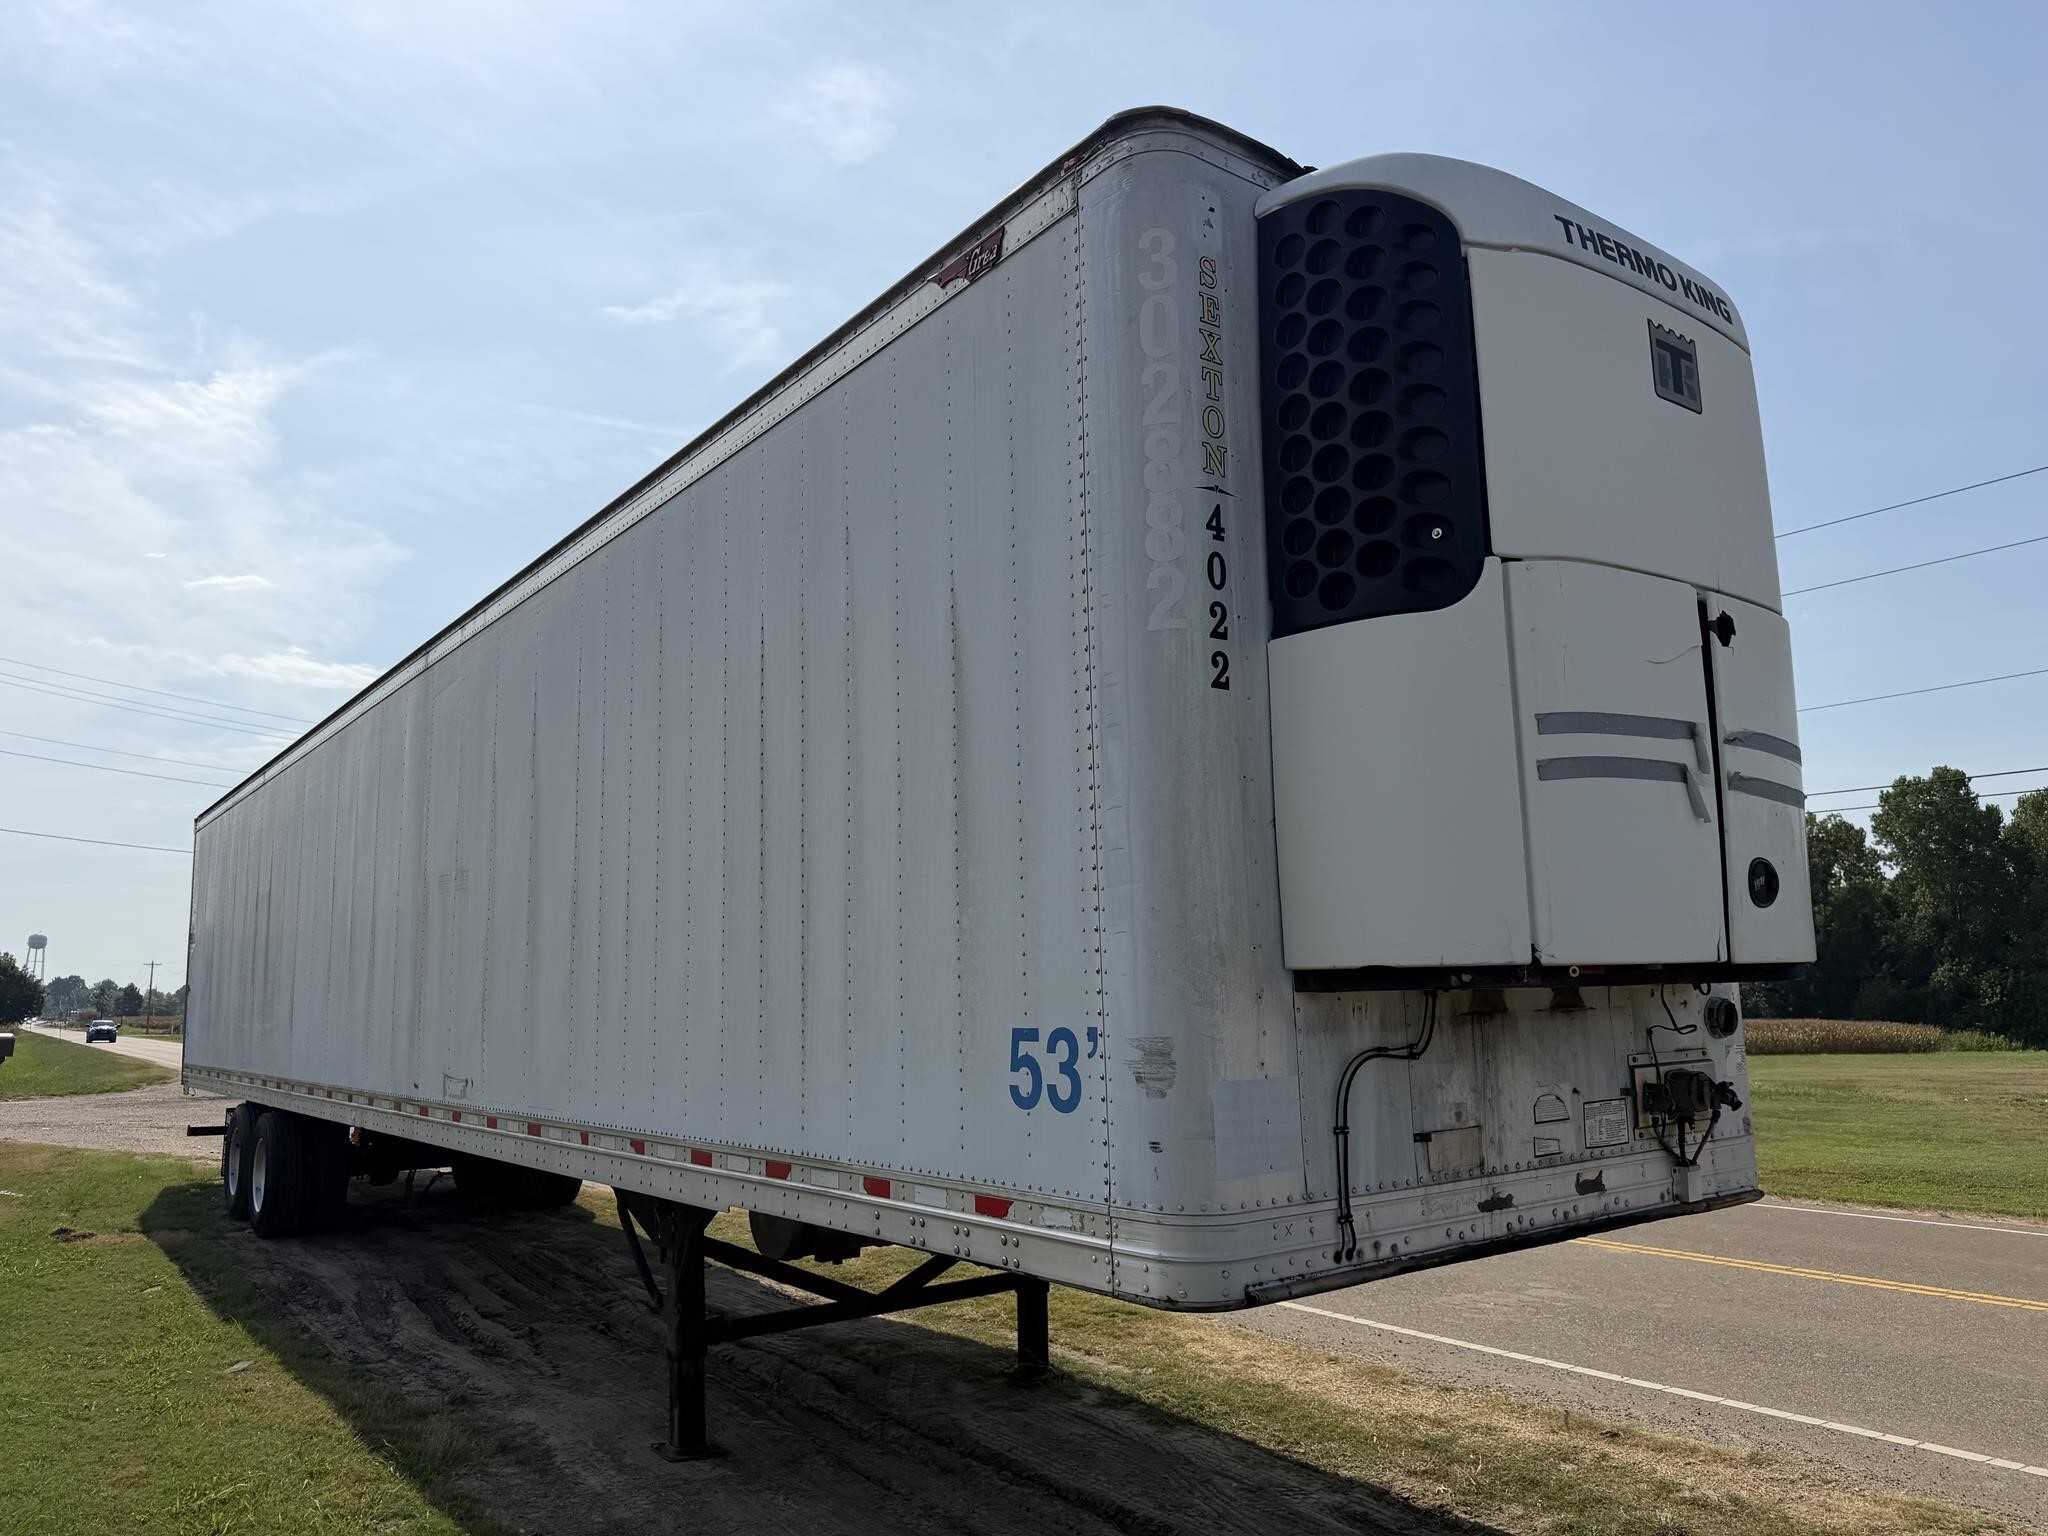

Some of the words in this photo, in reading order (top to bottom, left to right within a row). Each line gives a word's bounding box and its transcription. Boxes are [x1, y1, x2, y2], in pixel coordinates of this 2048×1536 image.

[1554, 214, 1677, 292] THERMO
[1678, 273, 1733, 325] KING
[1199, 256, 1228, 479] SEXTON
[1205, 503, 1231, 692] 4022
